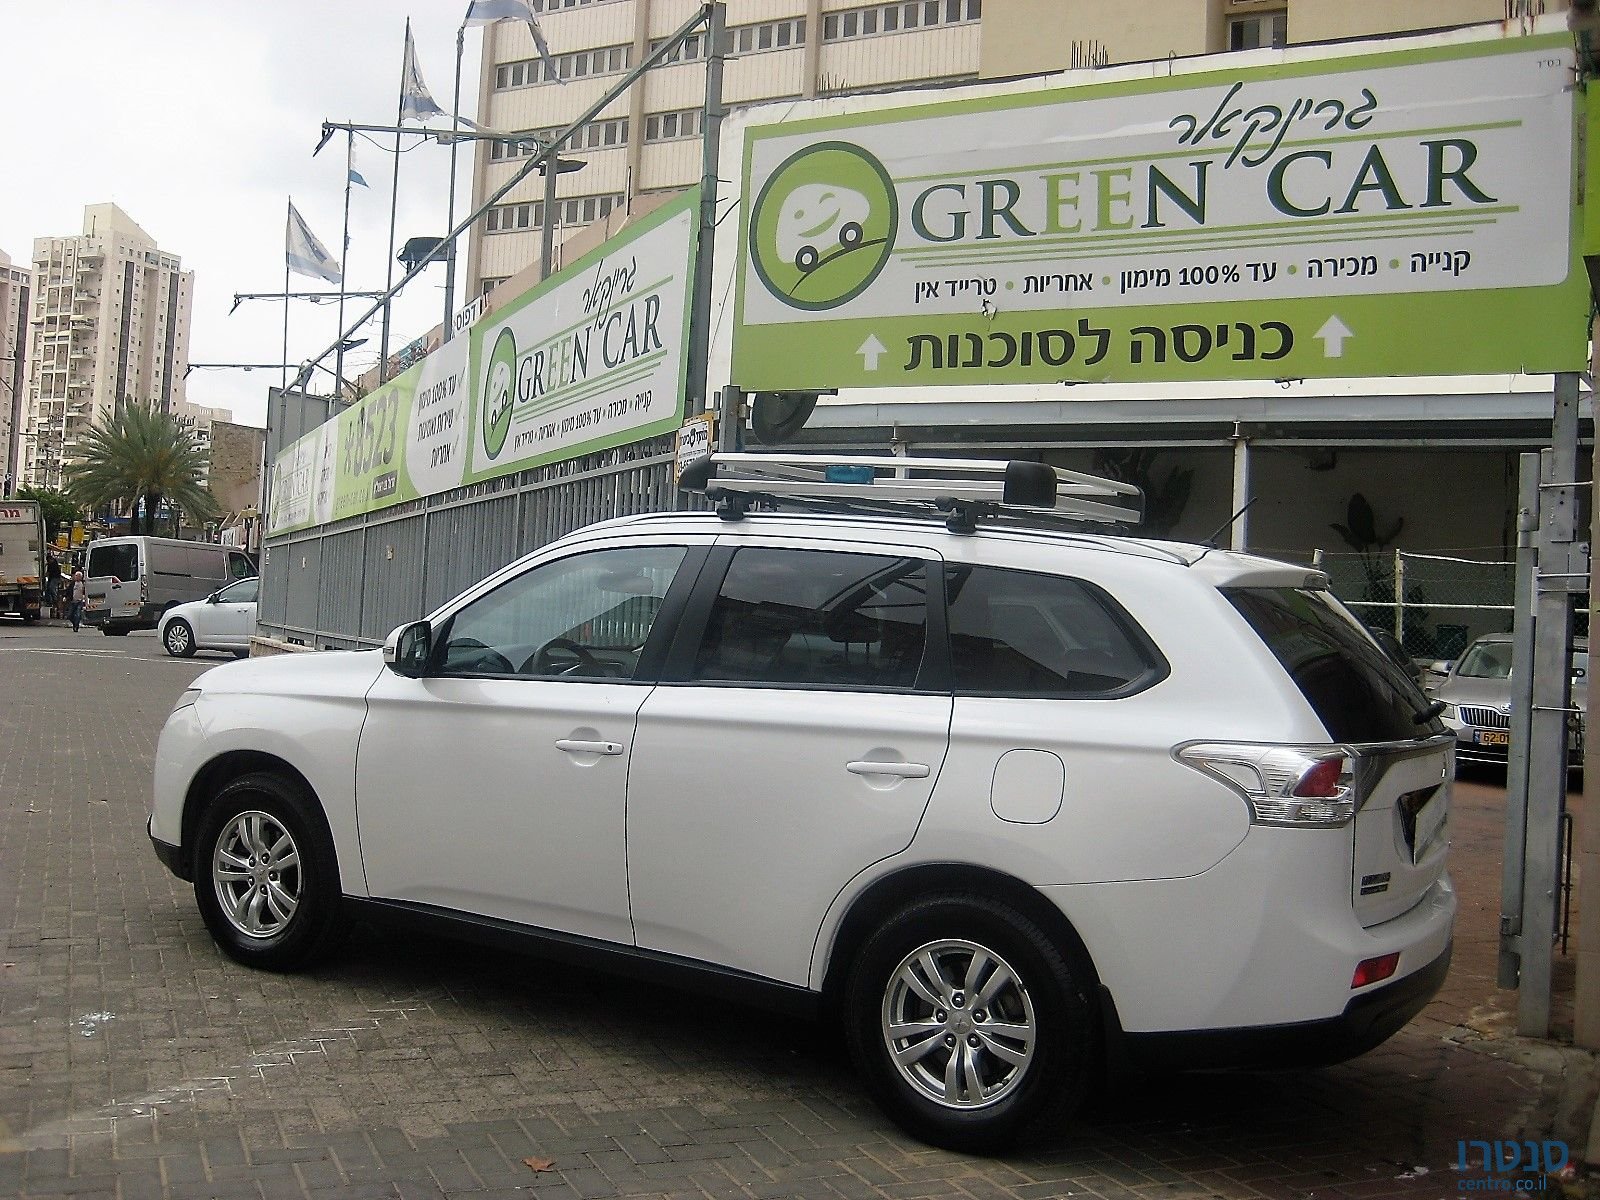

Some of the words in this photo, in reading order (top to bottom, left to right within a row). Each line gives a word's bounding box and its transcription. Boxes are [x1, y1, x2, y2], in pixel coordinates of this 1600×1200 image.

[1168, 81, 1378, 169] גרינקאר
[911, 160, 1213, 242] GREEN
[1266, 138, 1498, 217] CAR
[1246, 261, 1277, 282] עד
[1307, 255, 1378, 278] מכירה
[1411, 249, 1471, 276] קנייה
[945, 277, 997, 297] טרייד
[1023, 273, 1093, 294] אחריות
[1120, 267, 1171, 294] מימון
[1179, 264, 1240, 287] 100%
[915, 281, 939, 303] אין
[518, 326, 591, 403] GREEN
[603, 294, 662, 369] CAR
[904, 318, 1111, 371] לסוכנות
[1130, 320, 1294, 364] כניסה
[607, 399, 628, 419] מכירה
[634, 390, 652, 412] קנייה
